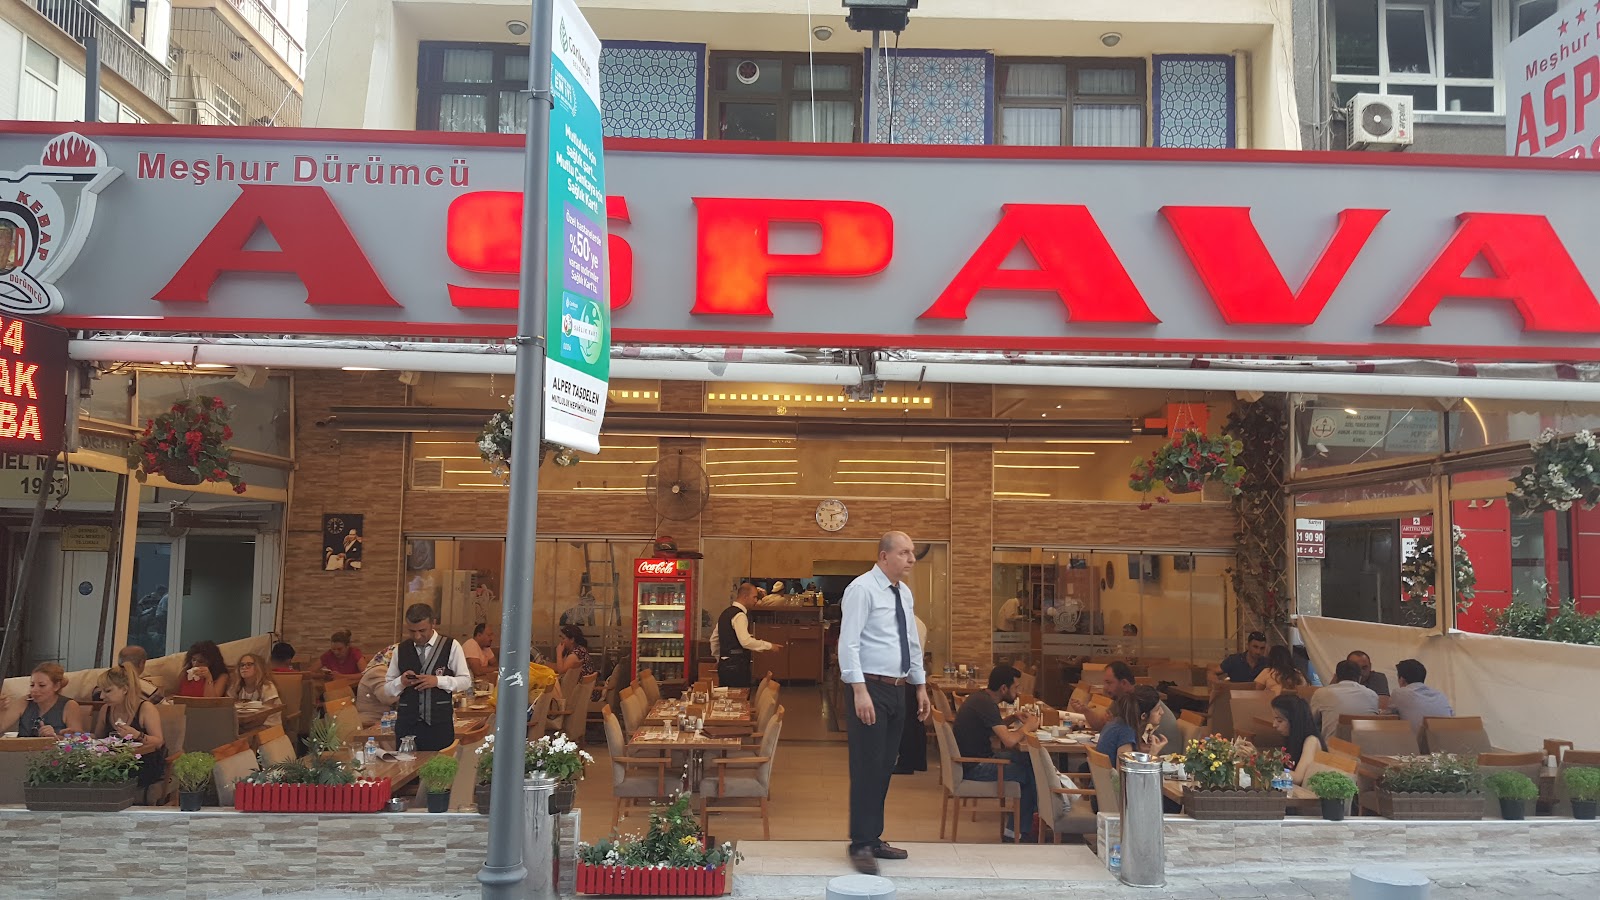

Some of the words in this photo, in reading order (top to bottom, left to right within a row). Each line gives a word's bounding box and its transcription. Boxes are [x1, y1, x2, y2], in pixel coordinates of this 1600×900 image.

[1526, 32, 1590, 81] Meşhur
[137, 152, 280, 186] Meşhur
[293, 153, 470, 188] Dürümcü
[556, 150, 574, 177] Mutlu
[567, 177, 585, 203] Sağlık
[16, 190, 52, 261] KEBAP
[565, 208, 577, 228] Özel
[150, 184, 1600, 334] ASPAVA
[0, 317, 25, 355] 4
[552, 376, 572, 395] ALPER
[572, 384, 600, 405] TAŞDELEN
[0, 454, 29, 470] EL
[1304, 532, 1314, 542] 90
[1314, 532, 1324, 542] 90
